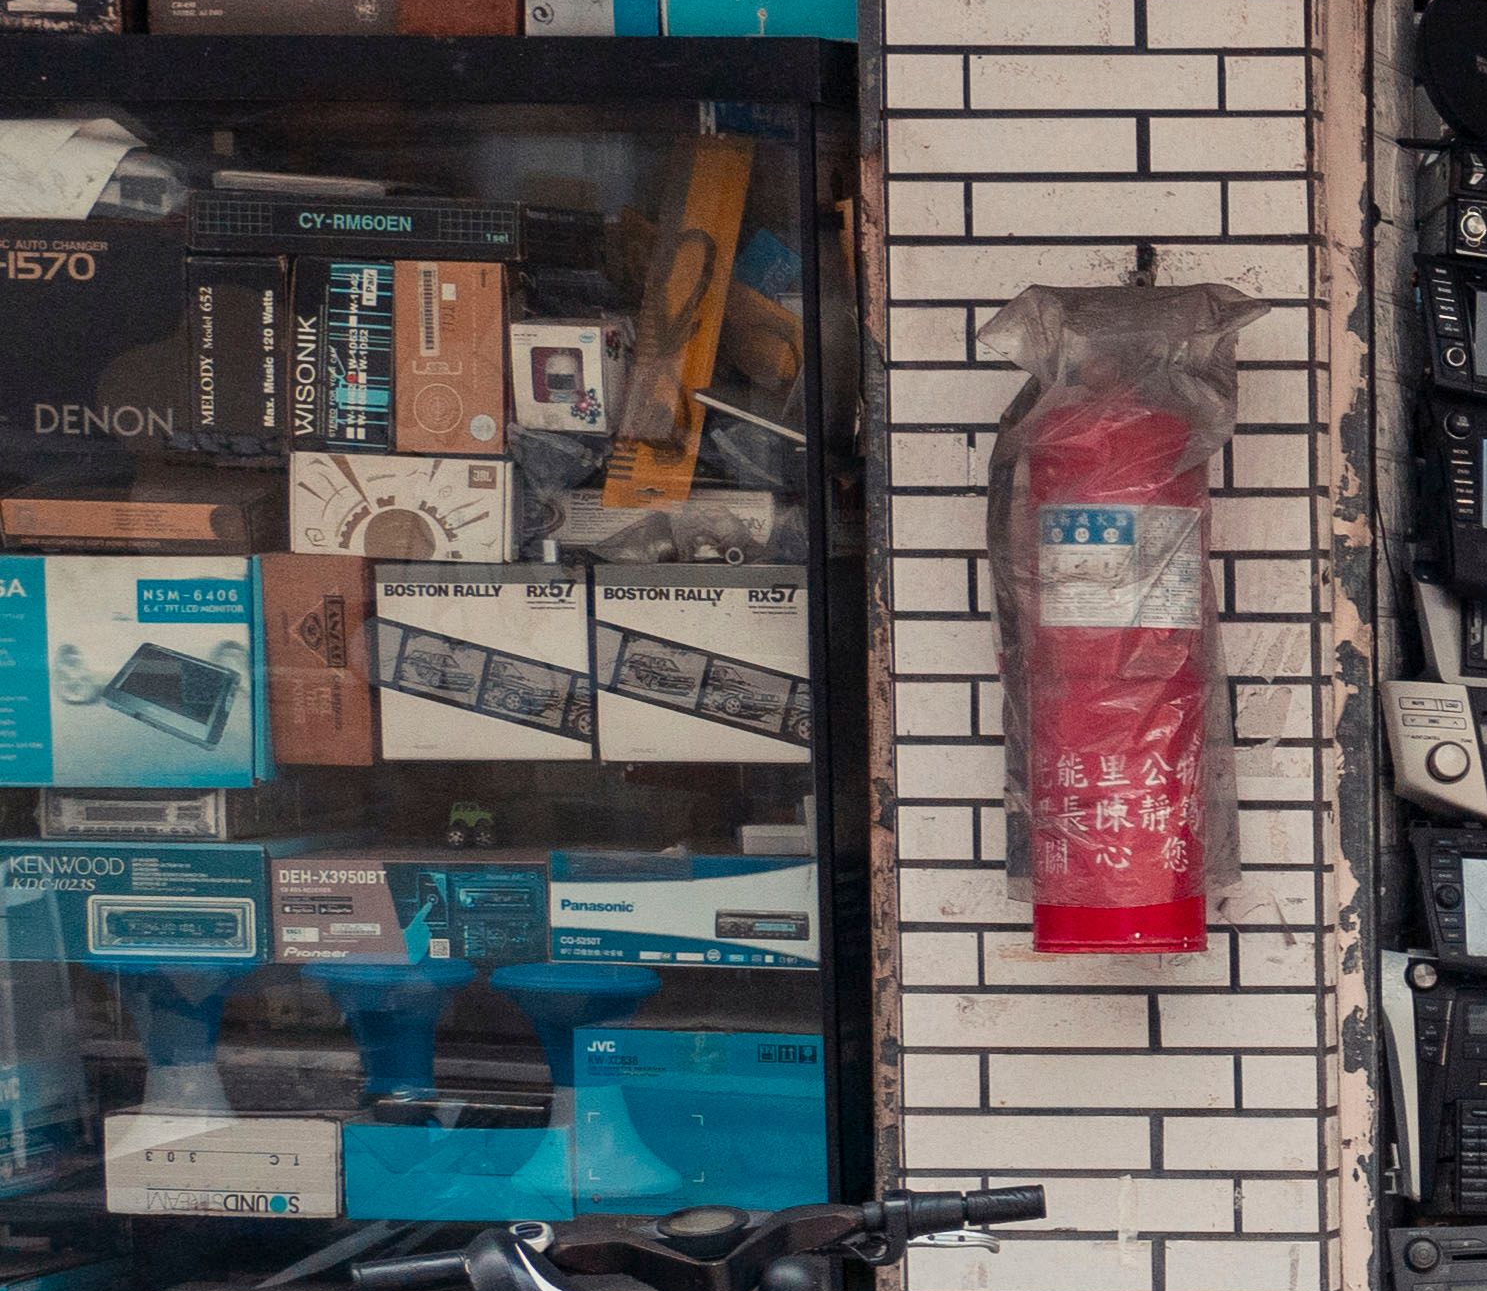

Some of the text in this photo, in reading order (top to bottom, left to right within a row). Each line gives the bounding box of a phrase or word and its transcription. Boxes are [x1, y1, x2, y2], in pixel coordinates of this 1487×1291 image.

[298, 212, 413, 232] CY-RM60EN
[14, 241, 109, 253] AUTO CHANGER
[263, 289, 274, 324] Watts
[263, 329, 274, 351] 120
[199, 286, 215, 425] MELODY Model 652
[263, 355, 274, 394] Music
[295, 315, 317, 436] WISONIK
[34, 404, 174, 438] DENON
[143, 590, 239, 602] NSM-6406
[385, 579, 577, 599] BOSTON RALLY RX57
[604, 584, 798, 604] BOSTON RALLY RX57
[8, 856, 125, 877] KENWOOD
[279, 870, 387, 885] DEH-X3950BT
[560, 899, 634, 913] Panasonic
[283, 946, 350, 959] Pioneer
[587, 1041, 616, 1053] JVC
